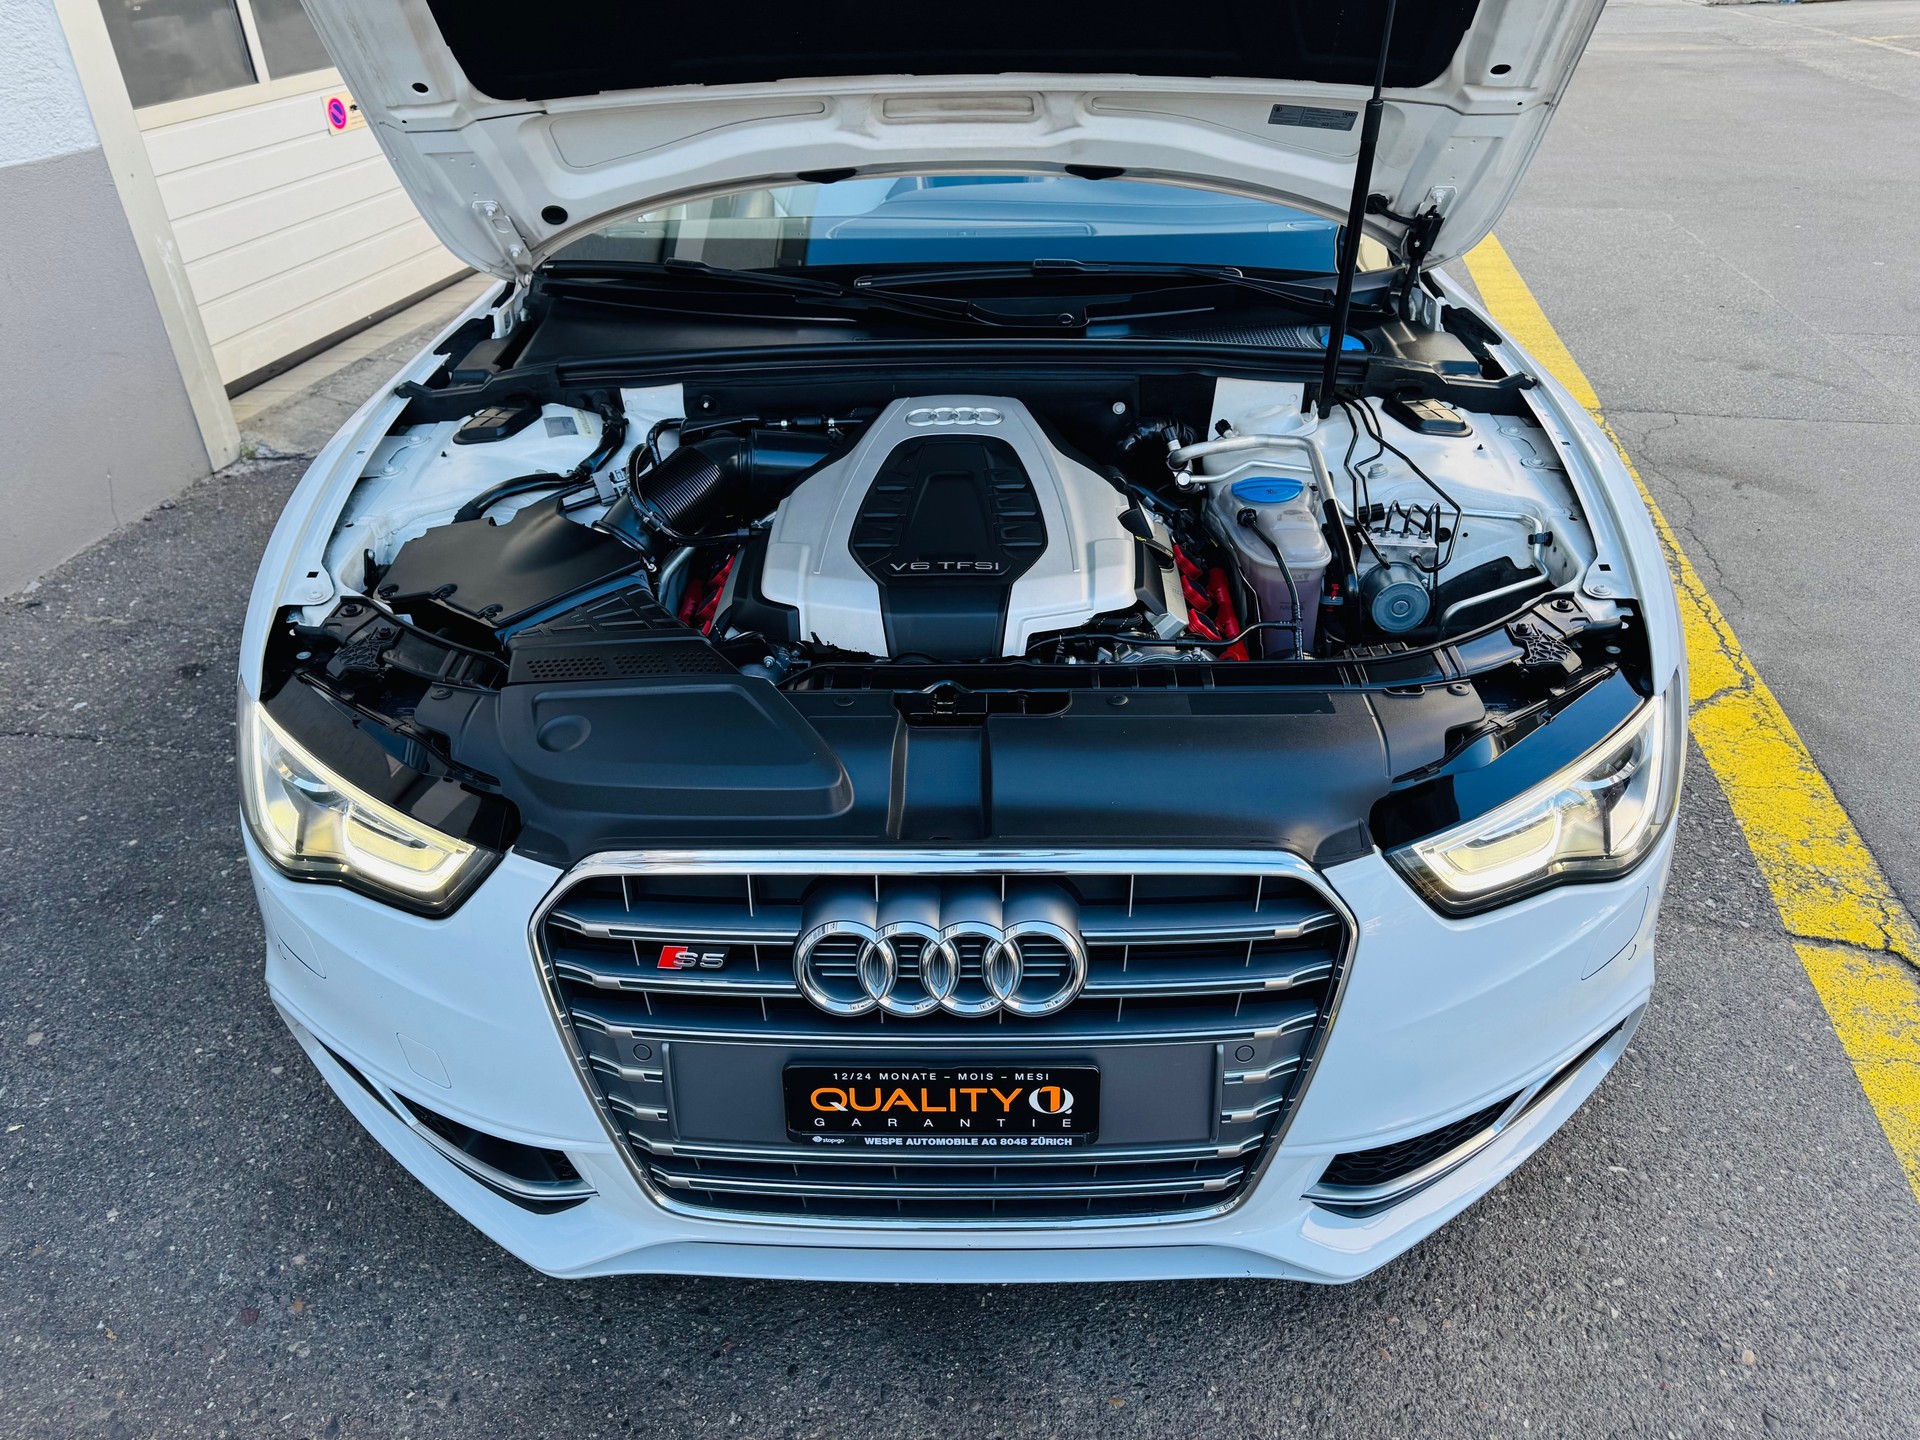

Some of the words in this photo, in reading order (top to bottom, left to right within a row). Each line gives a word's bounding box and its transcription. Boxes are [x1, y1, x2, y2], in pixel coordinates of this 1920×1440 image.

[889, 561, 930, 571] V6
[937, 561, 999, 571] TFSI
[673, 951, 726, 969] S5
[833, 1072, 872, 1081] 12/24
[879, 1072, 937, 1081] MONATE
[958, 1072, 994, 1081] MOIS
[1014, 1072, 1050, 1081] MESI
[810, 1087, 1023, 1113] QUALITY
[814, 1117, 1072, 1128] GARANTIE
[864, 1137, 903, 1146] WESPE
[905, 1137, 979, 1146] AUTOMOBILE
[981, 1137, 998, 1146] AG
[1000, 1137, 1028, 1146] 8048
[1030, 1136, 1073, 1146] ZÜRICH
